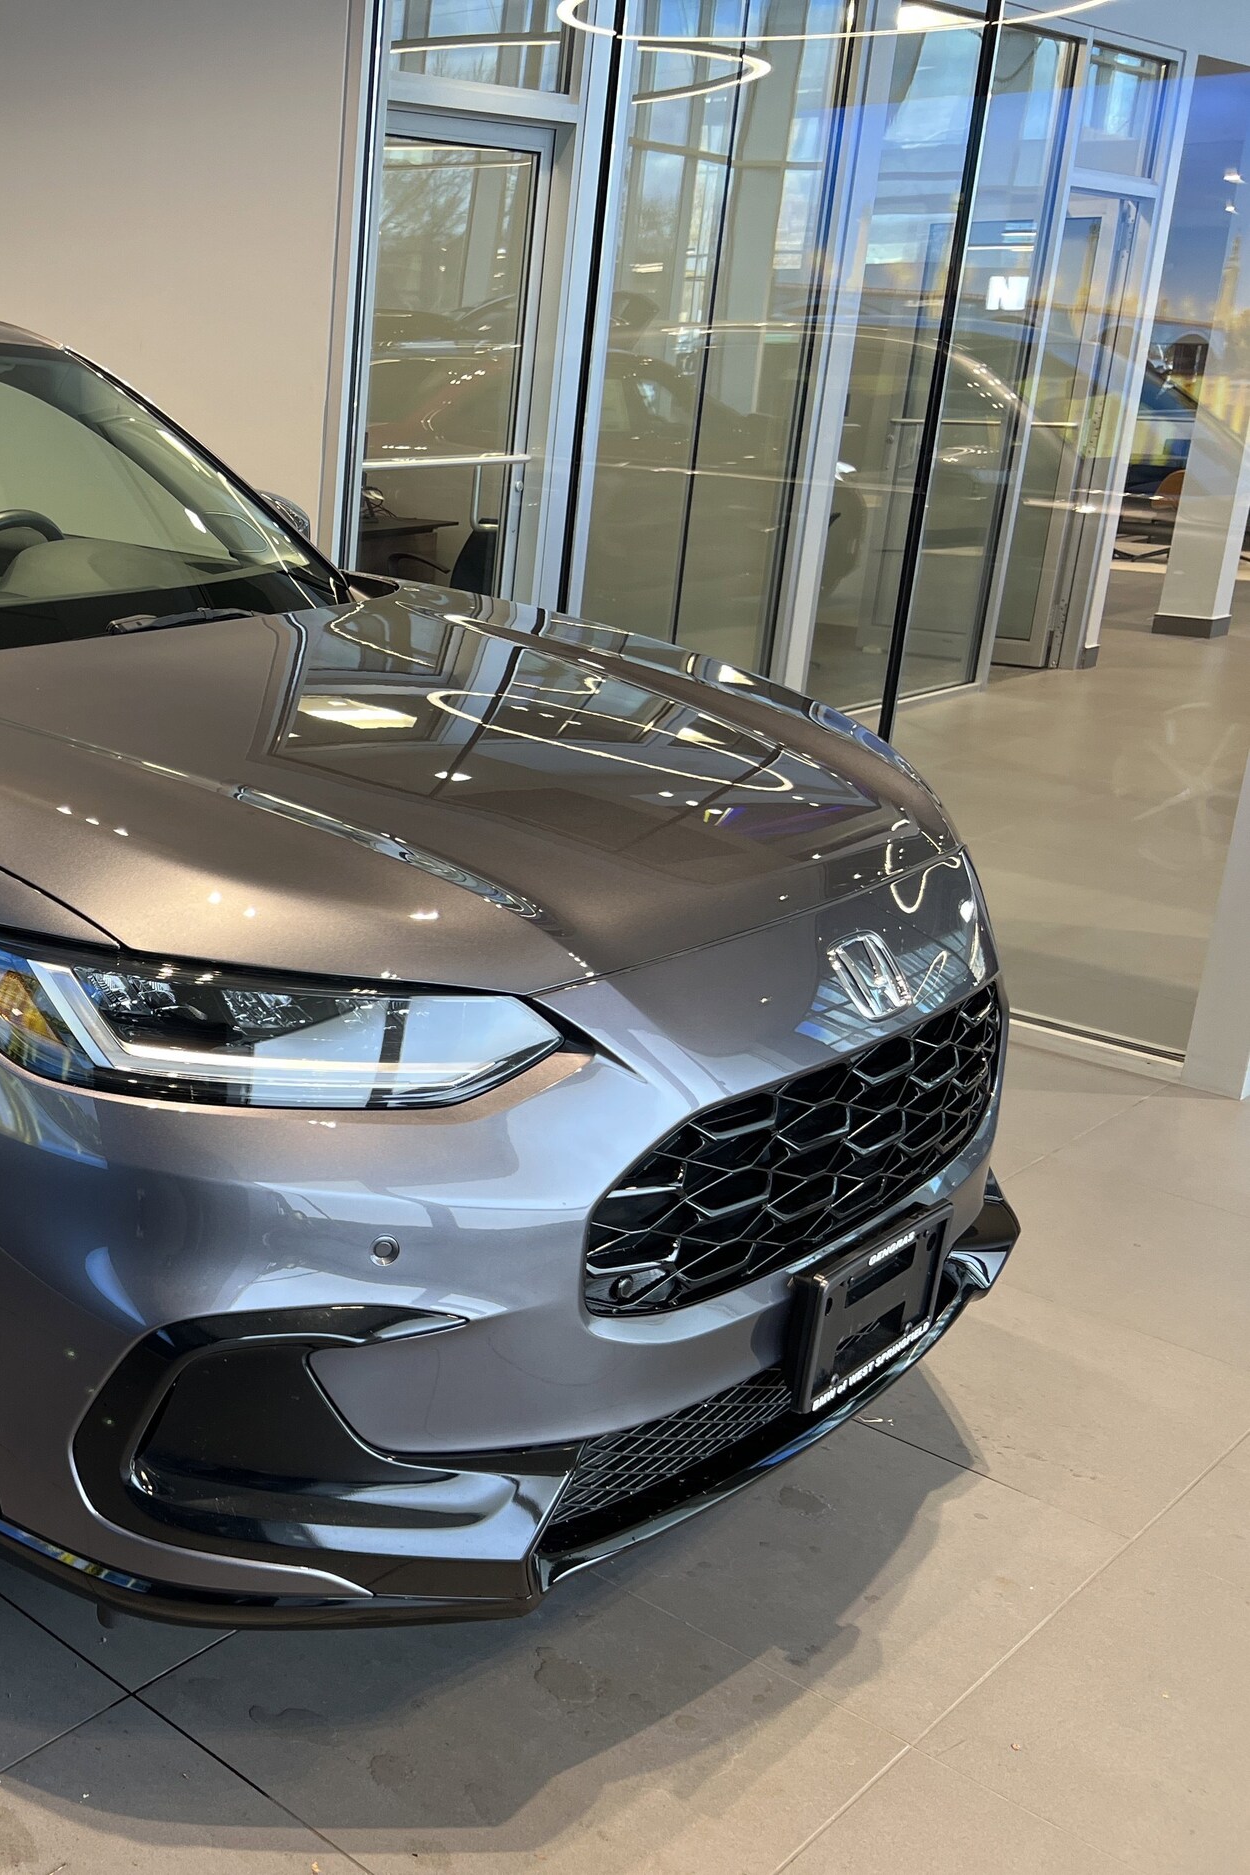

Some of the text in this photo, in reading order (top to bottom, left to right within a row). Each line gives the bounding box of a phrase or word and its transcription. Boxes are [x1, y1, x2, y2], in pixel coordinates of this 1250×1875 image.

[811, 1321, 930, 1412] BMW of WEST SPRINGFIELD
